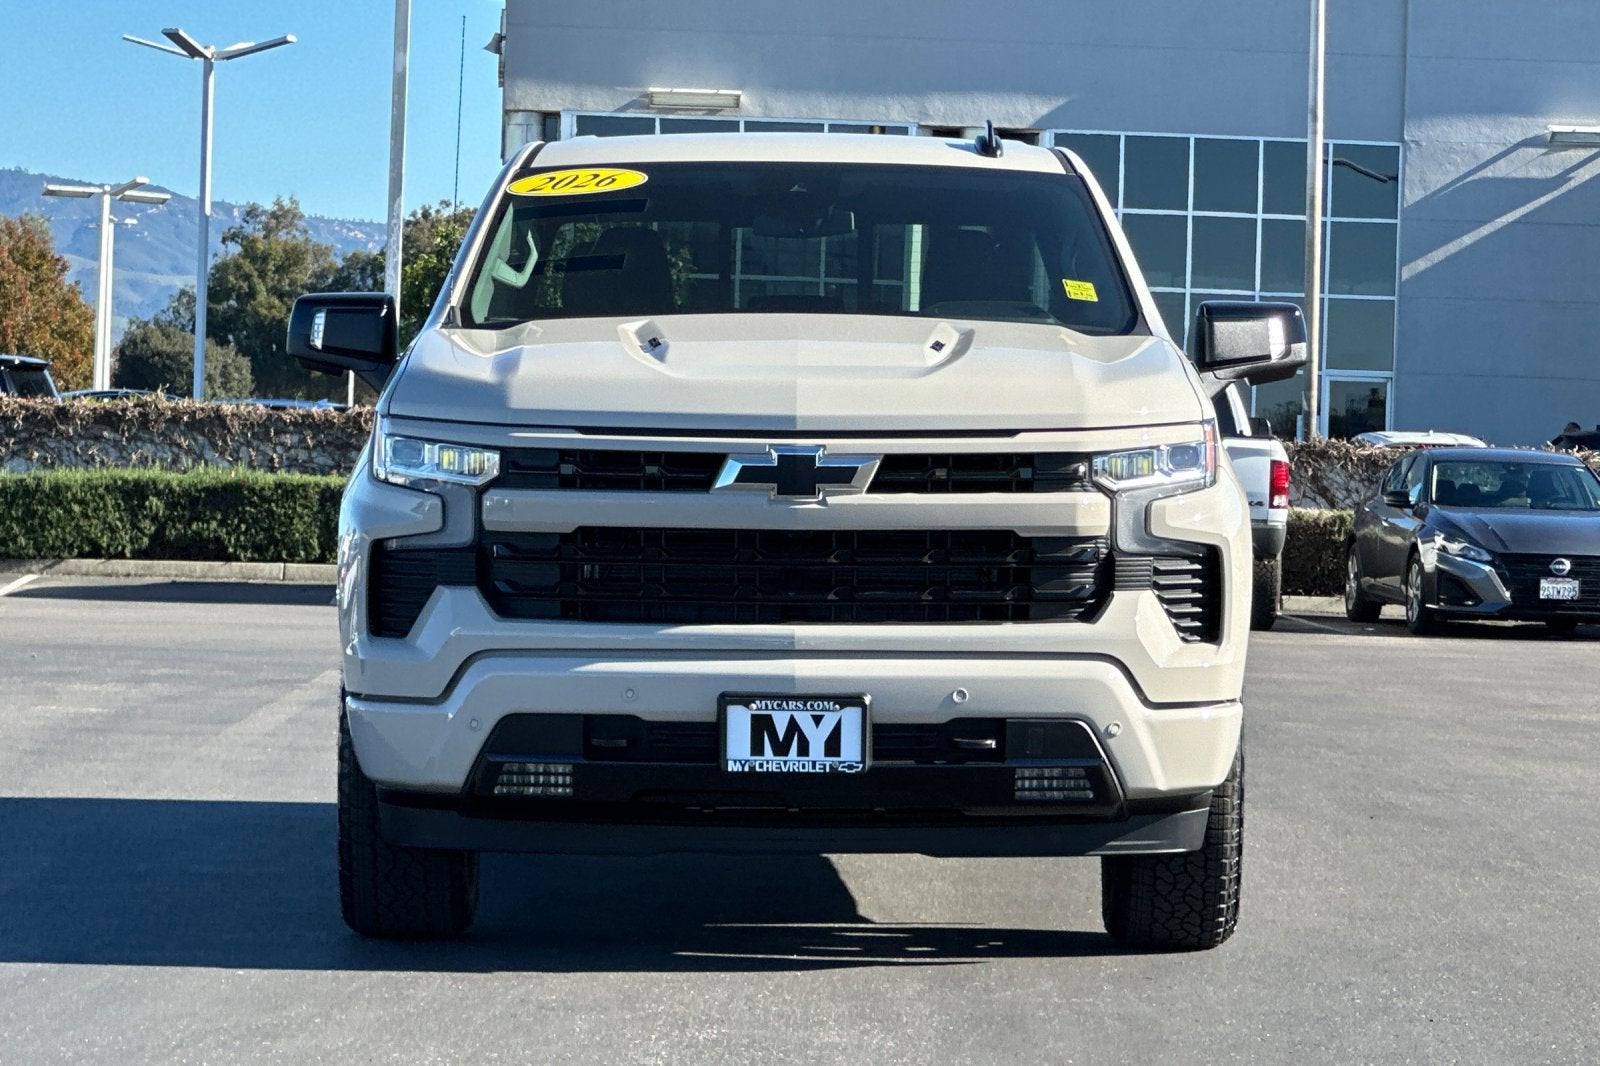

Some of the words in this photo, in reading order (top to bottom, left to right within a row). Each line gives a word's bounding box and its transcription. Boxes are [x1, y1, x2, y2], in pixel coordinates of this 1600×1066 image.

[526, 173, 626, 193] 2026
[756, 701, 834, 711] MYCARS.COM
[750, 713, 842, 758] MY
[727, 760, 750, 772] MY
[755, 761, 832, 773] CHEVROLET
